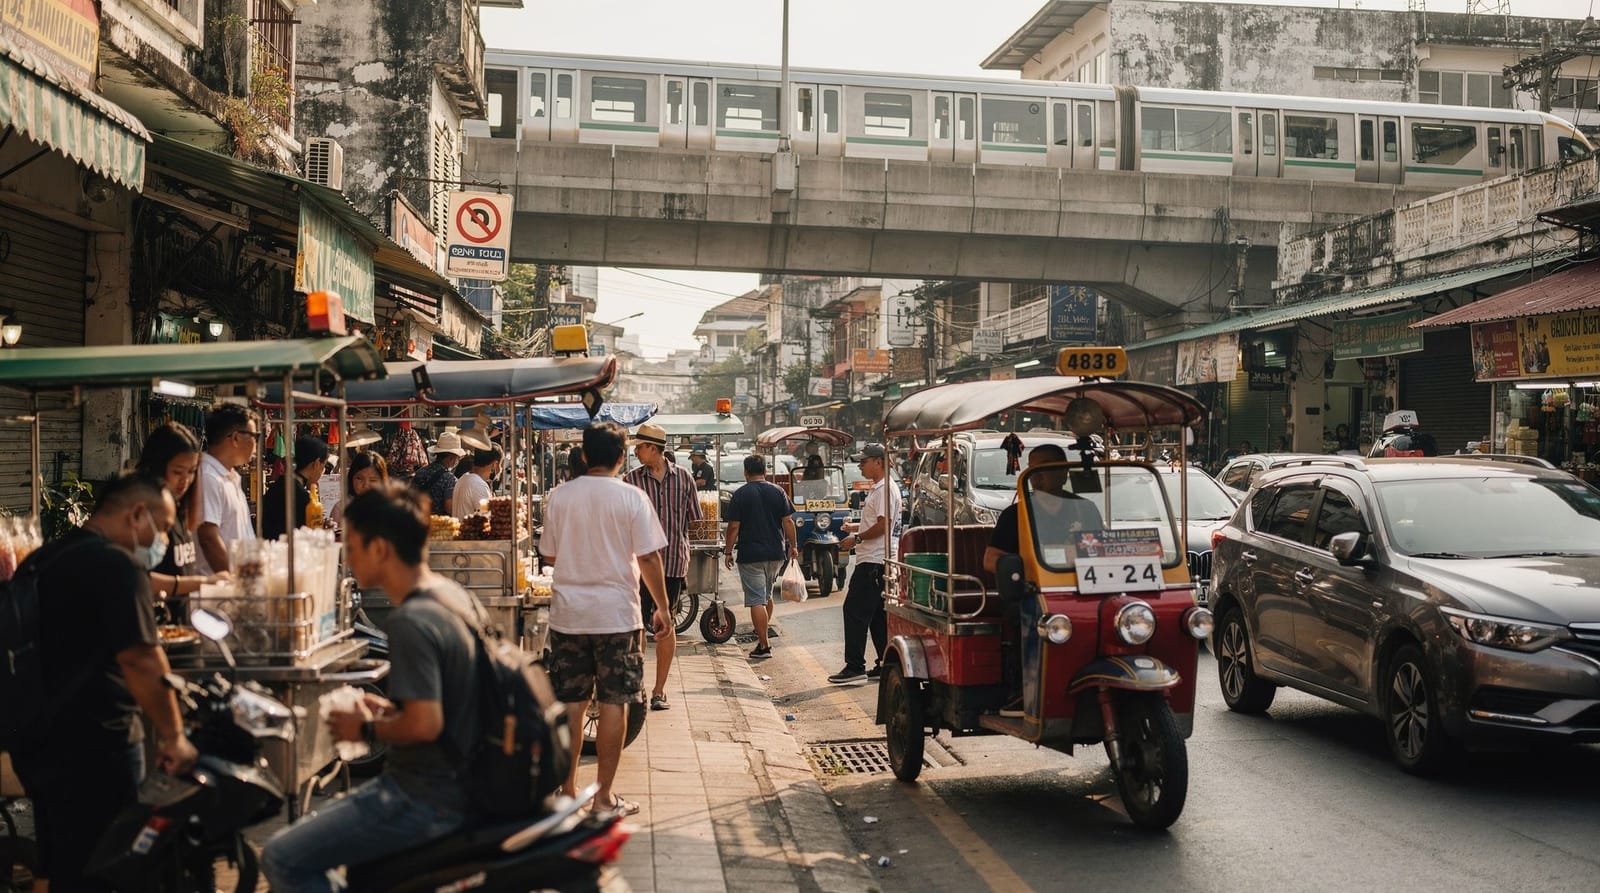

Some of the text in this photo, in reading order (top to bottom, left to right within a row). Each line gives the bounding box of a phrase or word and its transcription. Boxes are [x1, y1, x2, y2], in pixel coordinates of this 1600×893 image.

[1068, 353, 1116, 370] 4838
[1084, 565, 1097, 585] 4
[1123, 563, 1157, 584] 24
